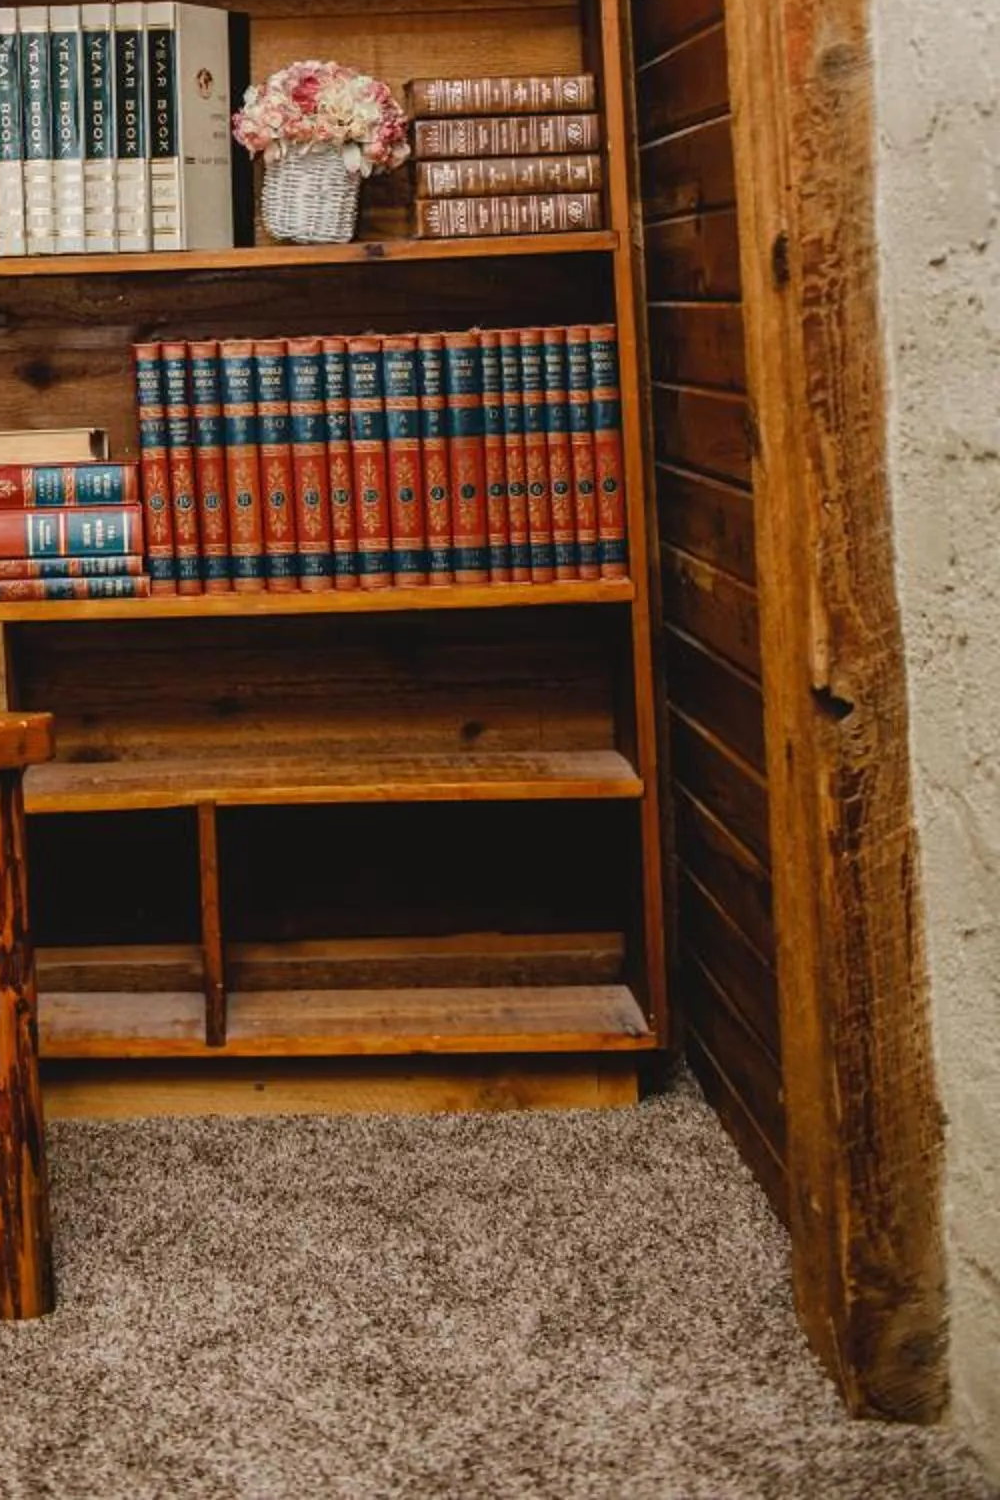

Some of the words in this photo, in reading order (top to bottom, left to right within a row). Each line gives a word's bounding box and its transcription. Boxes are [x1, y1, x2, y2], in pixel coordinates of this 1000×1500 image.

[0, 39, 9, 91] YEAR
[29, 39, 39, 90] YEAR
[59, 38, 69, 89] YEAR
[91, 38, 102, 89] YEAR
[124, 37, 135, 88] YEAR
[155, 36, 167, 88] YEAR
[1, 102, 12, 159] BOOK
[31, 101, 42, 155] BOOK
[60, 101, 71, 155] BOOK
[93, 100, 104, 153] BOOK
[125, 100, 136, 153] BOOK
[157, 100, 169, 152] BOOK
